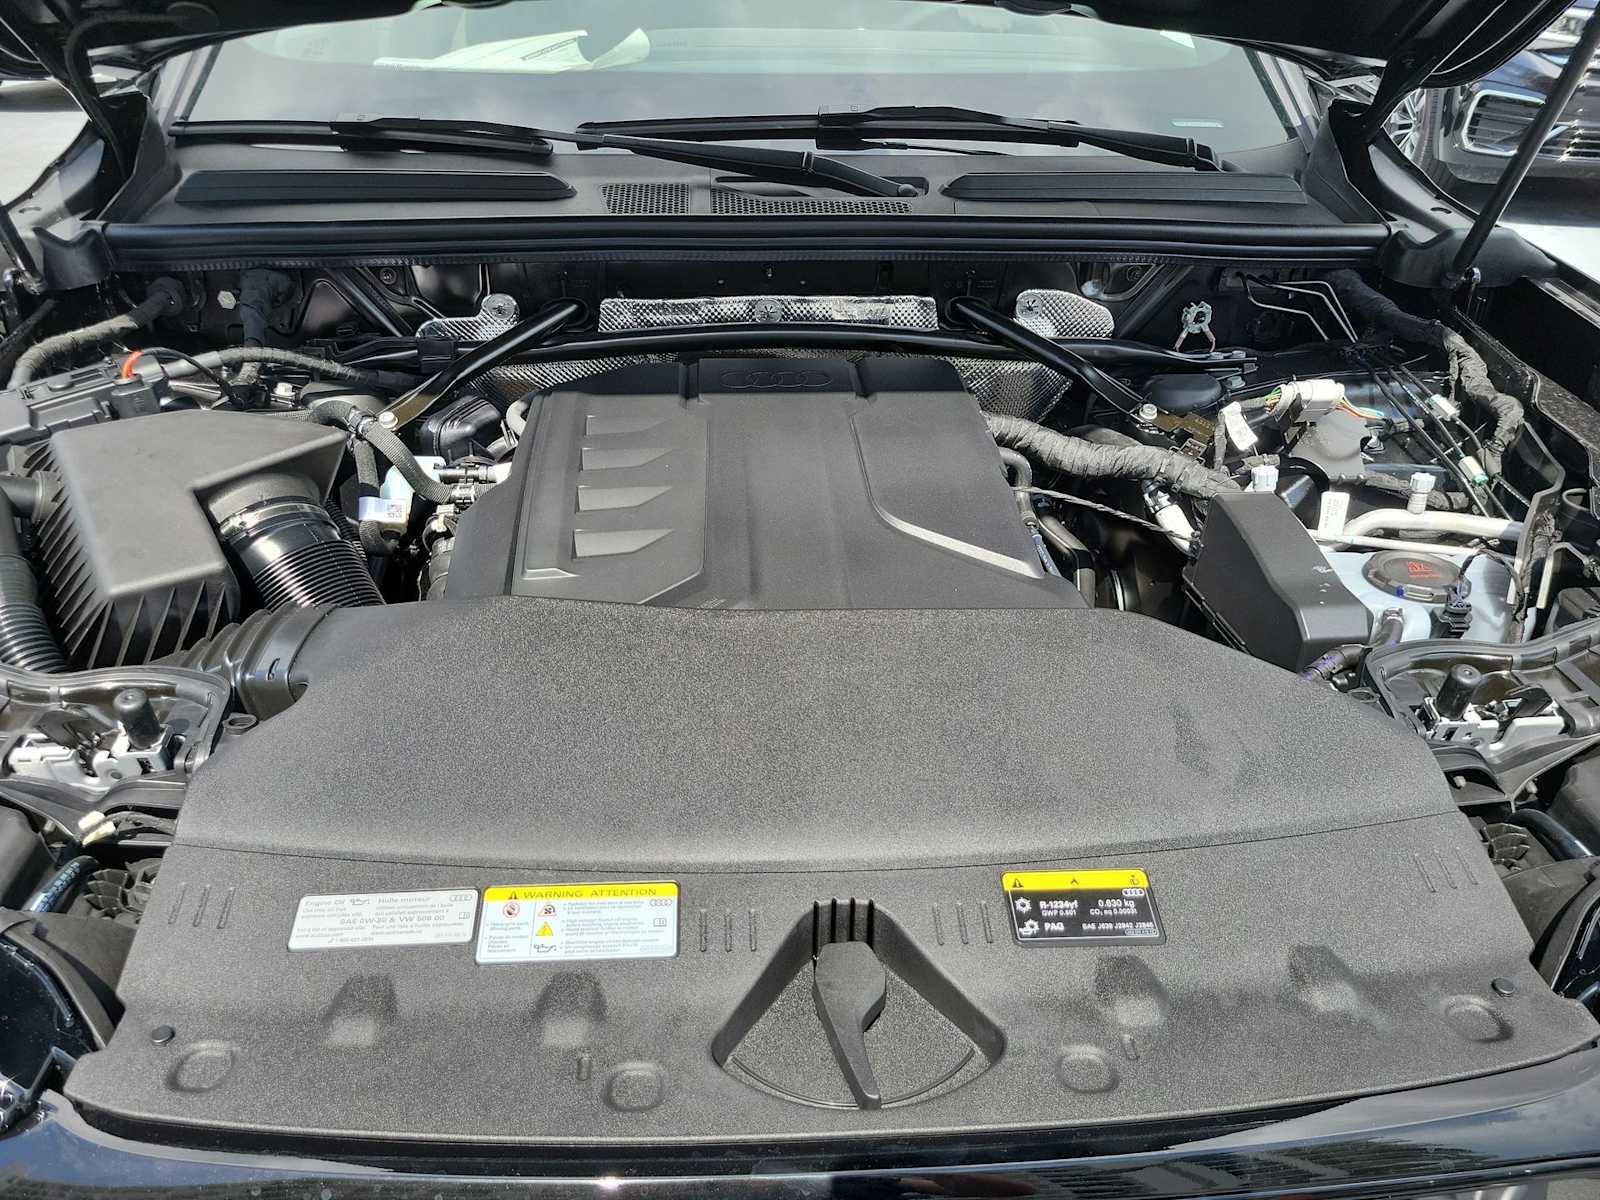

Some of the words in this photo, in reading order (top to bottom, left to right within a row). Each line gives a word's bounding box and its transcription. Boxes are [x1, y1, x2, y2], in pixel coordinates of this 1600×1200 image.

[523, 890, 583, 898] WARNING
[590, 888, 657, 897] ATTENTION
[1124, 899, 1136, 909] kg
[1044, 922, 1065, 931] PAG
